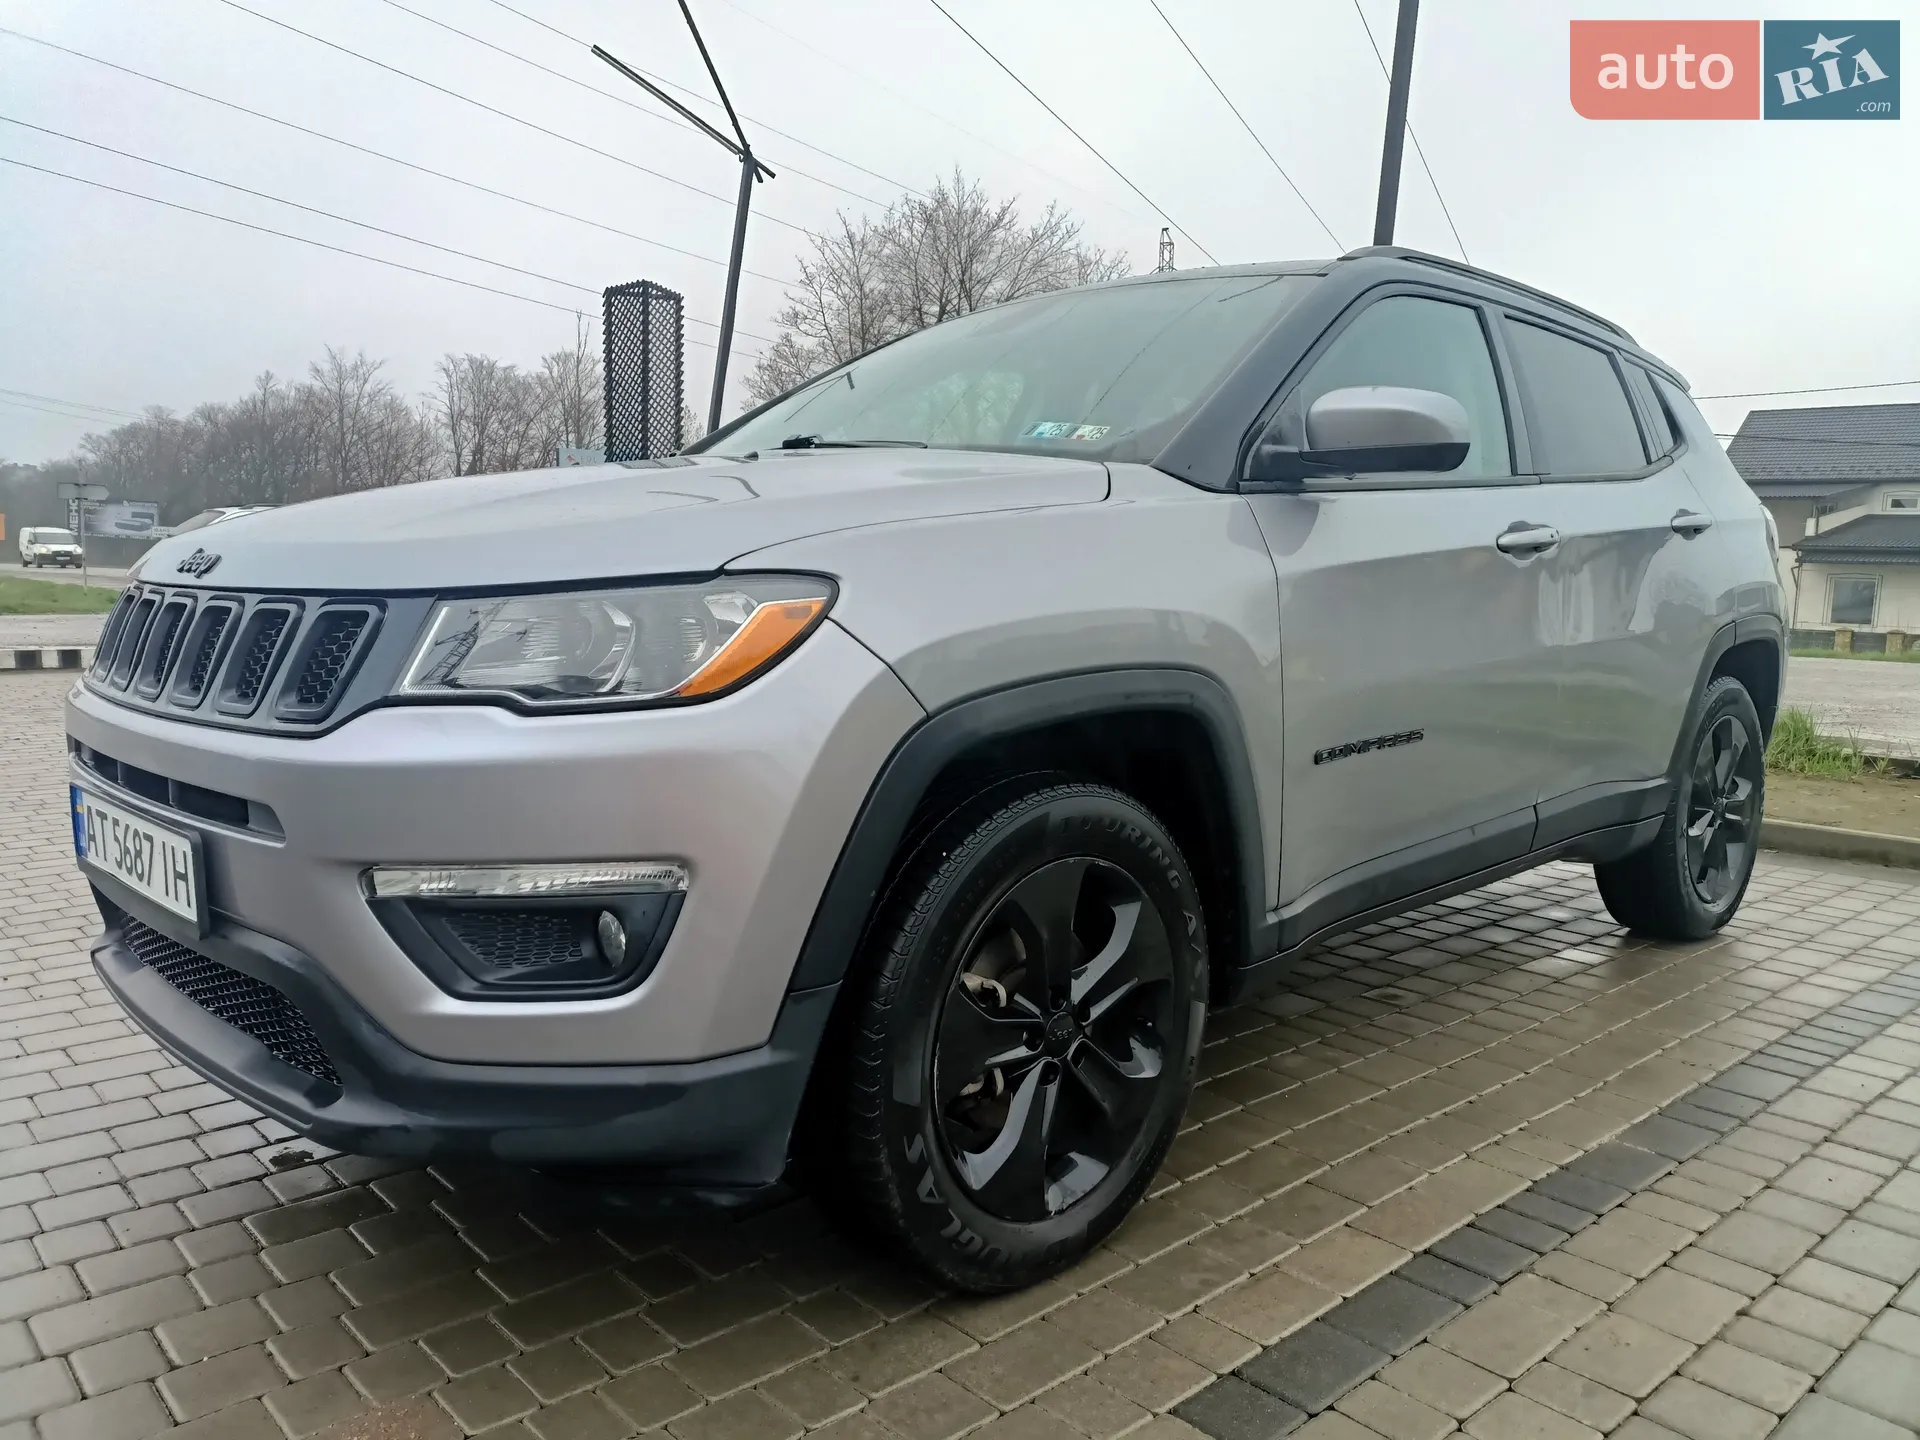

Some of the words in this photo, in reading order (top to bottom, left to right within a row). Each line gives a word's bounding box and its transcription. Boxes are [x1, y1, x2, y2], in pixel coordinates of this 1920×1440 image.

[176, 547, 222, 580] Jeep
[85, 804, 108, 863] AT
[111, 815, 154, 888] 5687
[161, 840, 192, 910] IH
